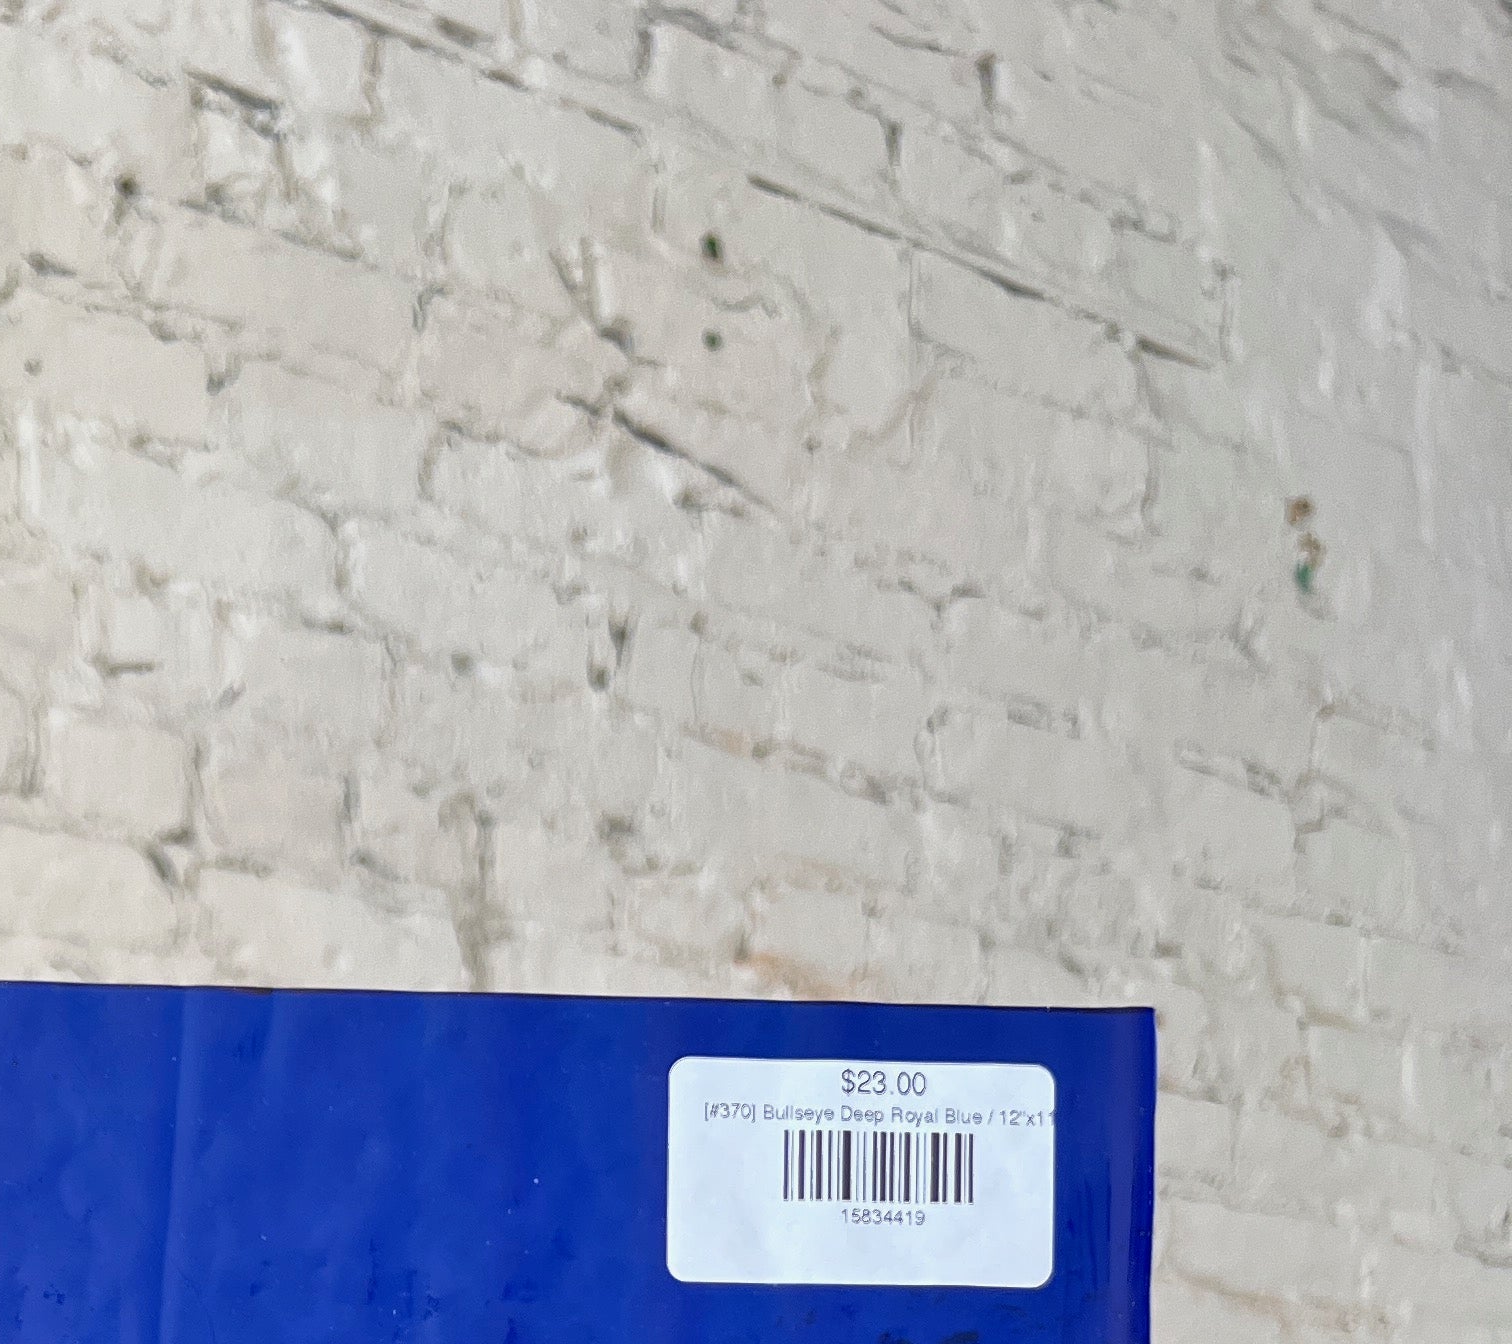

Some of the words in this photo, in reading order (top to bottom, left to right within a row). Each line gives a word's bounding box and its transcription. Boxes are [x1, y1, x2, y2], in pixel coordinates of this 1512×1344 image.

[841, 1068, 926, 1097] $23.00
[704, 1102, 756, 1123] [#370]
[763, 1103, 835, 1125] Bullseye
[840, 1105, 885, 1125] Deep
[891, 1106, 939, 1127] Royal
[945, 1107, 983, 1125] Blue
[987, 1109, 994, 1125] /
[841, 1208, 926, 1226] 15834419
